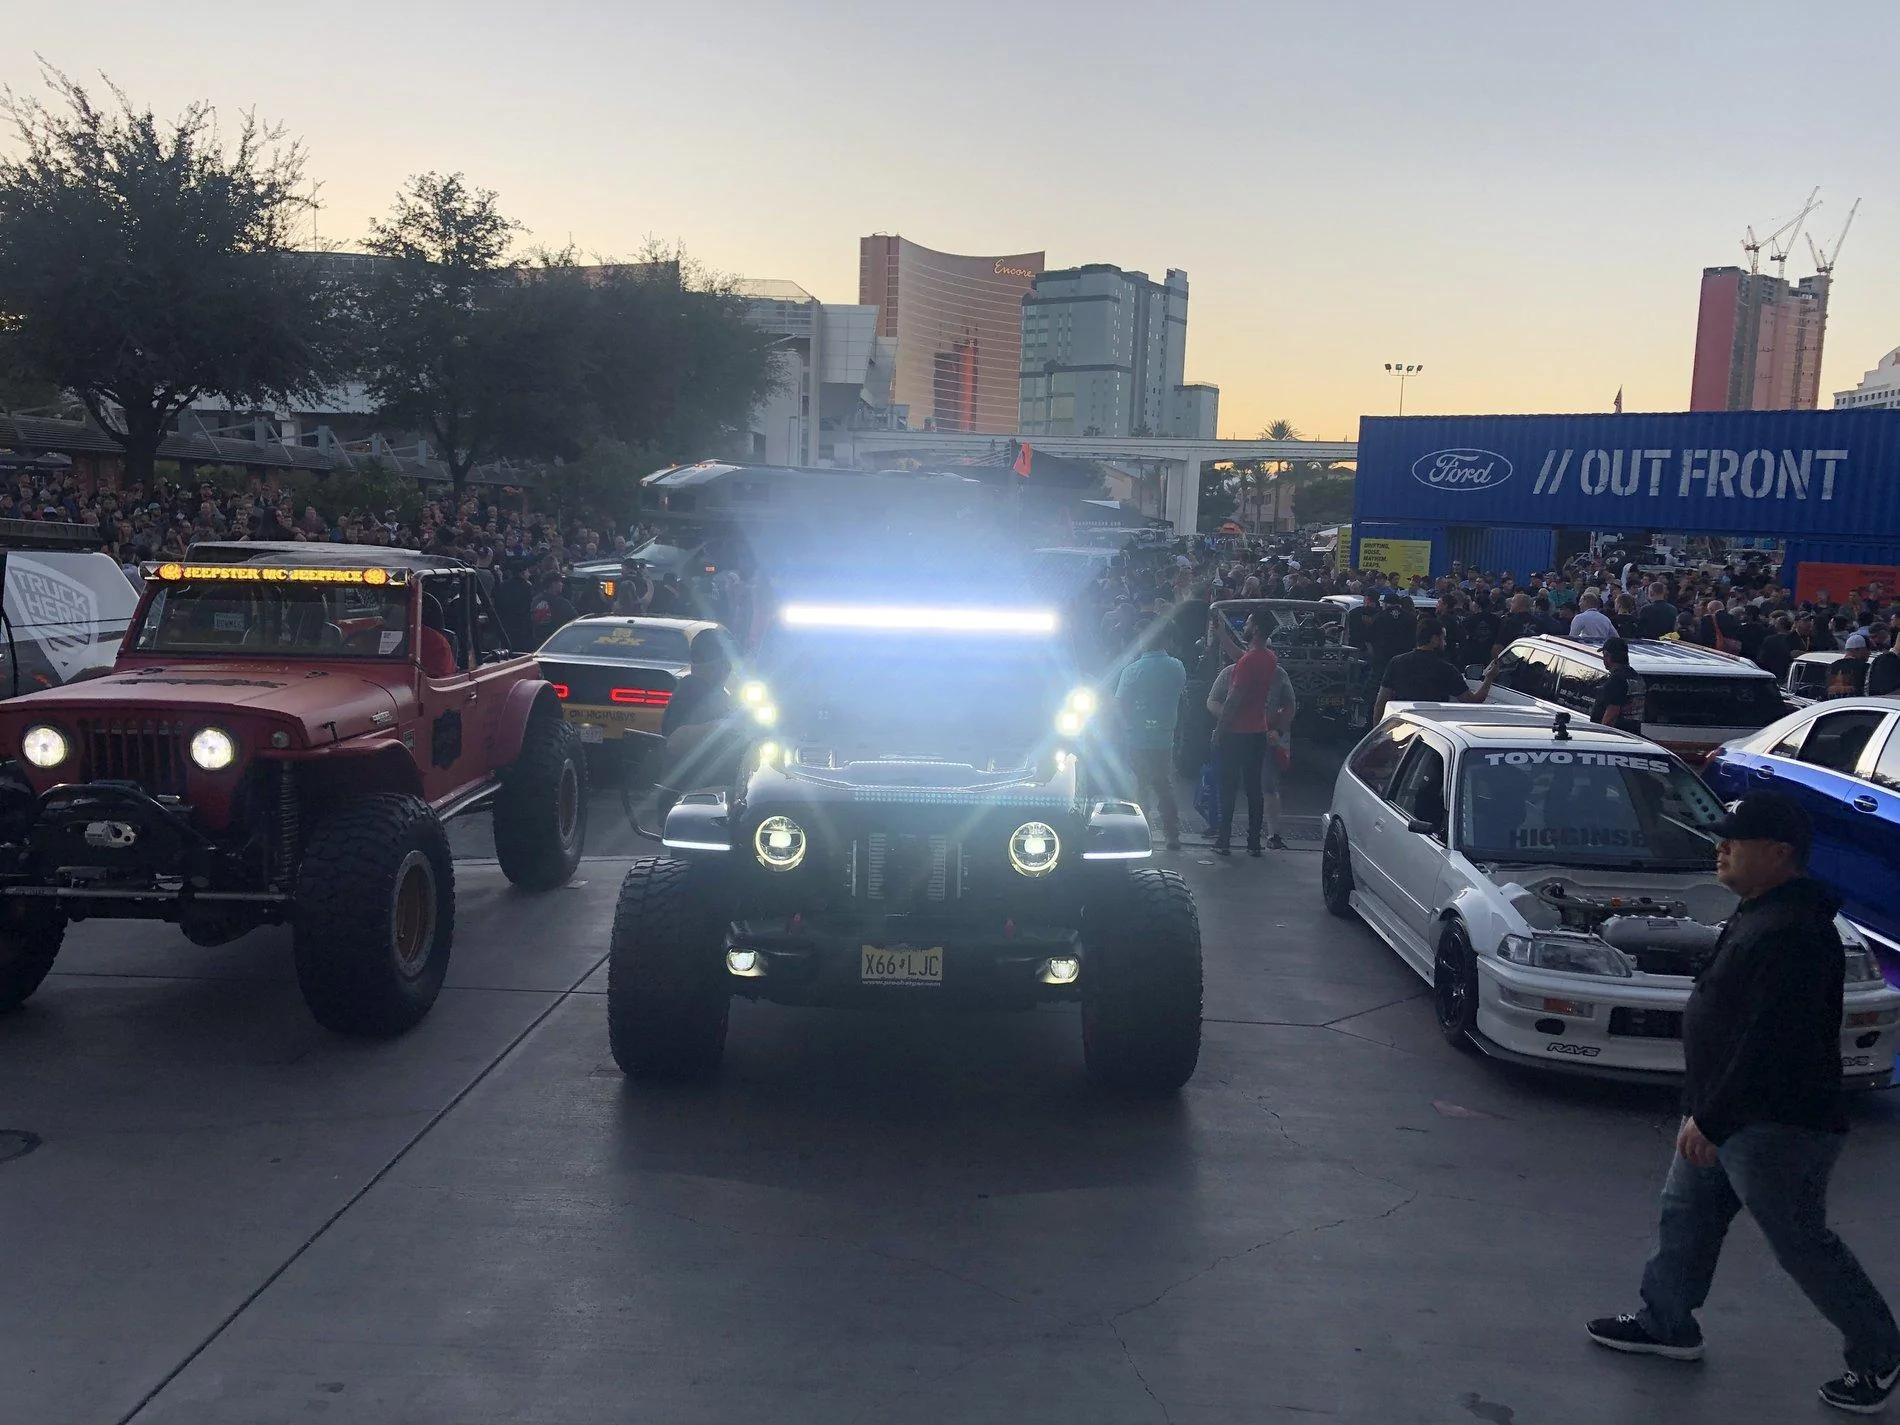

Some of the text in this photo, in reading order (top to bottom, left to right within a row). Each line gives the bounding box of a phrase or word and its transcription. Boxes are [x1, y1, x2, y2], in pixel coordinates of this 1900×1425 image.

[994, 258, 1036, 278] Encore
[1429, 454, 1492, 484] Ford
[1580, 449, 1671, 497] OUT
[1678, 449, 1848, 500] FRONT
[184, 567, 363, 582] JEEPSTER MC JEEPFACE
[15, 571, 88, 613] TRUCK
[25, 592, 88, 631] HERO
[1485, 751, 1671, 774] TOYO TIRES
[1547, 1042, 1602, 1058] RAYS
[1842, 1056, 1870, 1067] AYS
